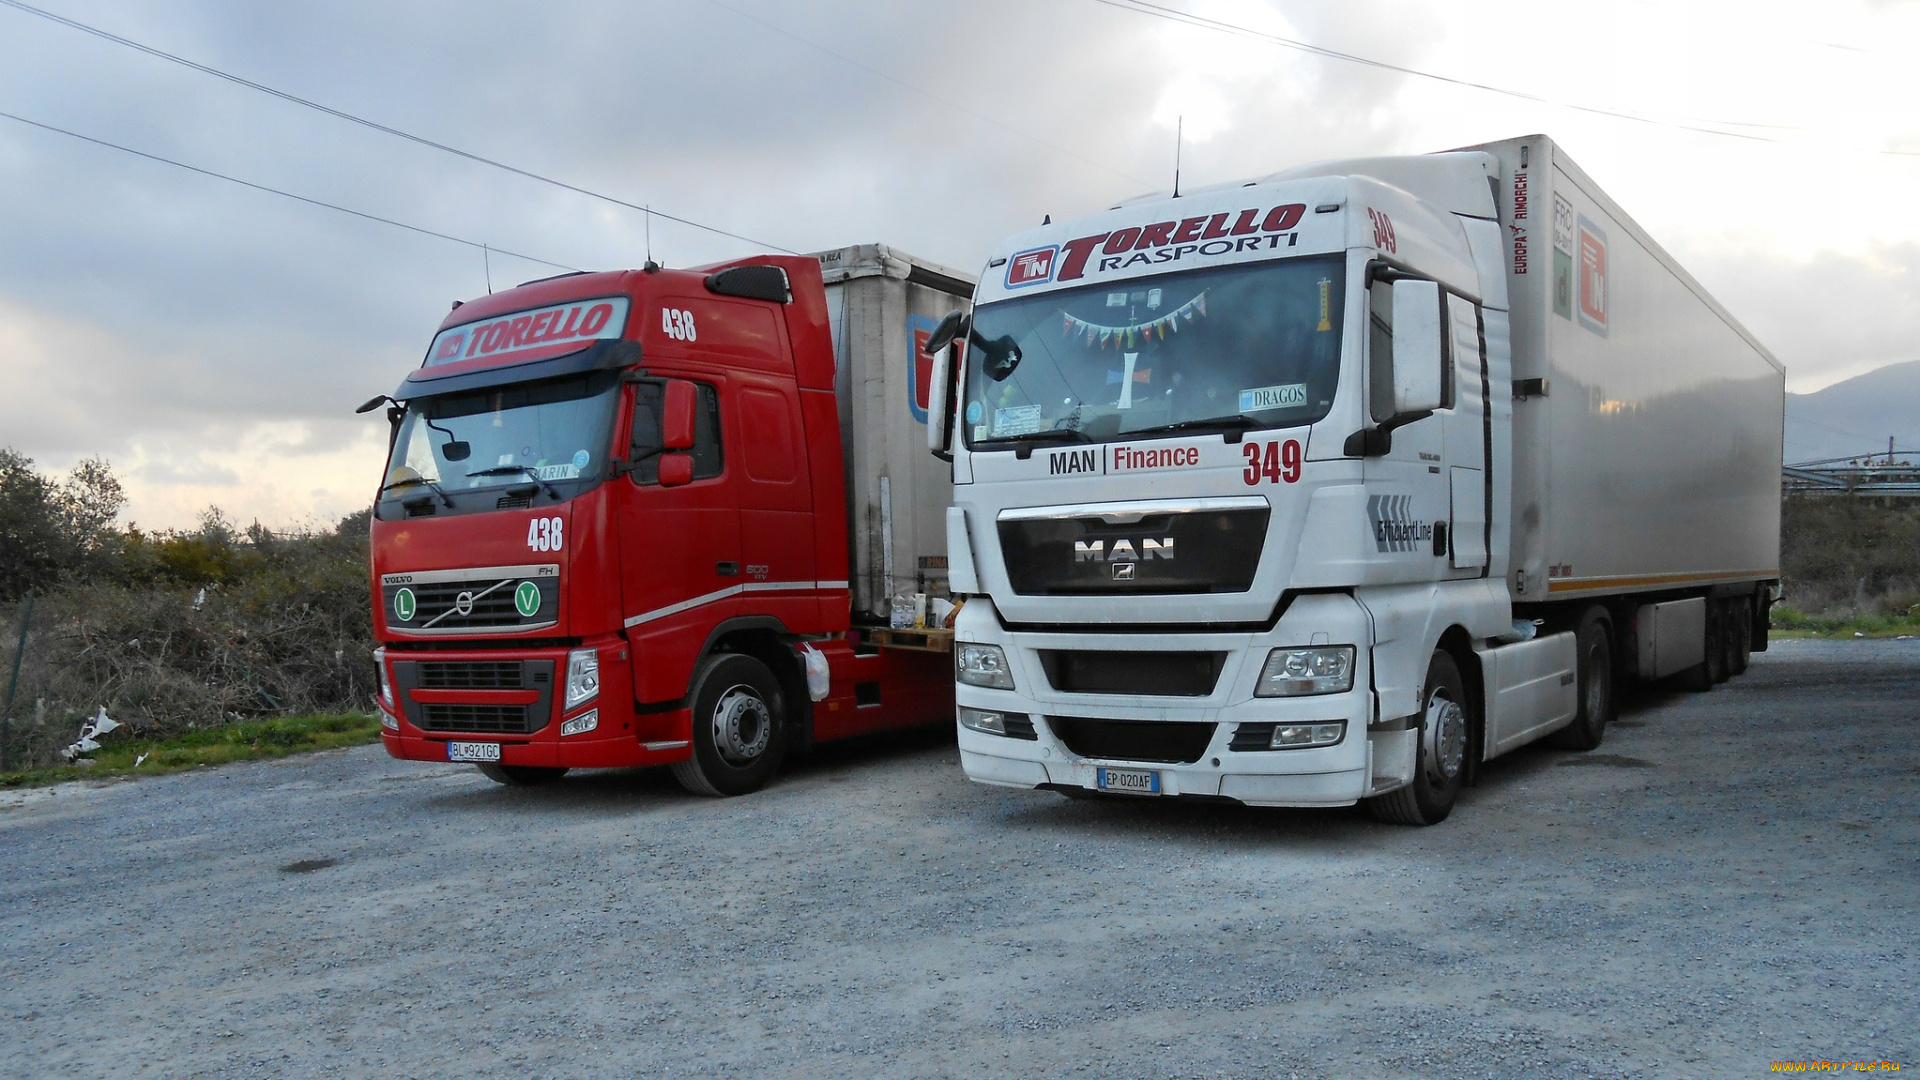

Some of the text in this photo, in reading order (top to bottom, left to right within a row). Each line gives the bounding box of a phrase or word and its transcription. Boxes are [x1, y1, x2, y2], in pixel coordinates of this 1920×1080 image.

[1367, 206, 1397, 255] 349
[1514, 173, 1528, 275] EUROPA RIMORCHI
[1555, 200, 1572, 232] FRC
[1057, 203, 1307, 282] TORELLO
[1098, 232, 1299, 272] RASPORTI
[465, 303, 613, 358] TORELLO
[662, 307, 697, 342] 438
[1254, 386, 1305, 407] DRAGOS
[1050, 447, 1199, 475] MAN Finance
[1242, 439, 1302, 487] 349
[527, 516, 564, 552] 438
[1074, 537, 1175, 562] MAN
[384, 567, 554, 584] VOLVO FH
[400, 594, 410, 615] L
[520, 589, 535, 611] V
[1106, 772, 1150, 788] EP 020AF
